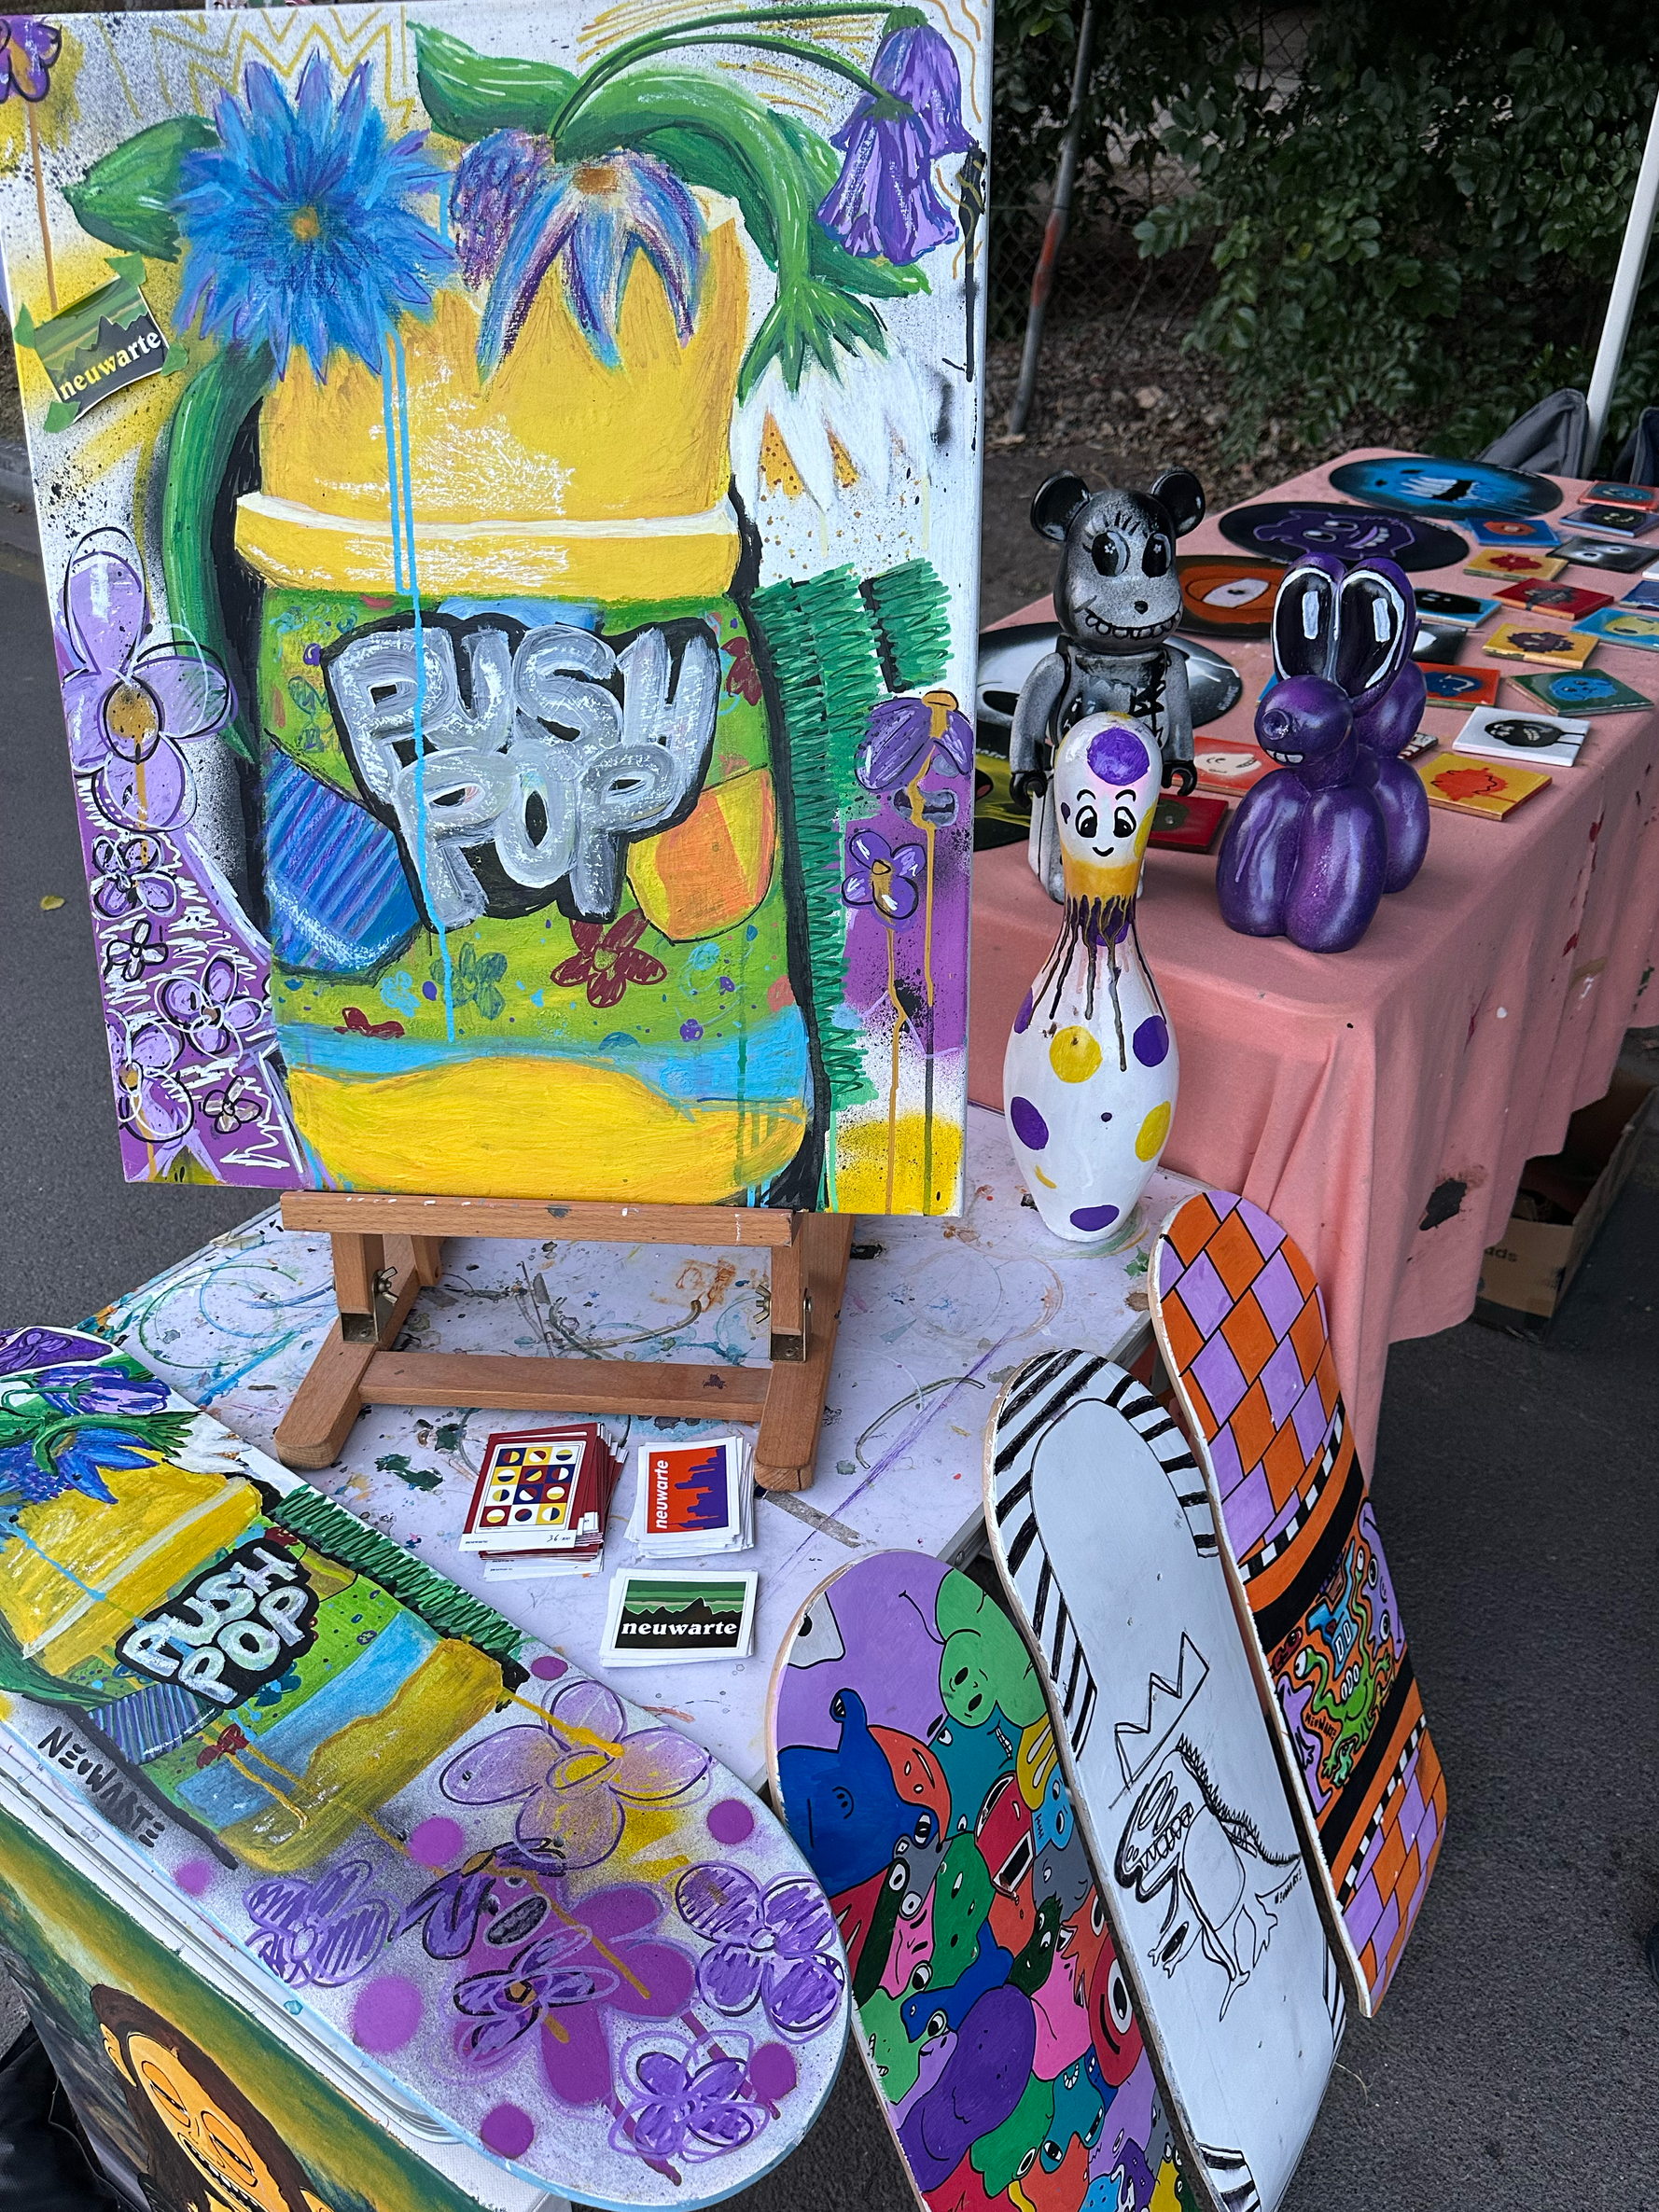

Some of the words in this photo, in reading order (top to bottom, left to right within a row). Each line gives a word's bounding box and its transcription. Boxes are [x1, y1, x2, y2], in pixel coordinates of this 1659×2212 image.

[59, 331, 162, 401] neuwarte
[328, 624, 722, 806] PUSH
[395, 744, 679, 929] POP
[654, 1459, 669, 1530] neuwarte
[121, 1547, 299, 1676] PUSH
[177, 1585, 309, 1704] POP
[620, 1621, 738, 1635] neuwarte
